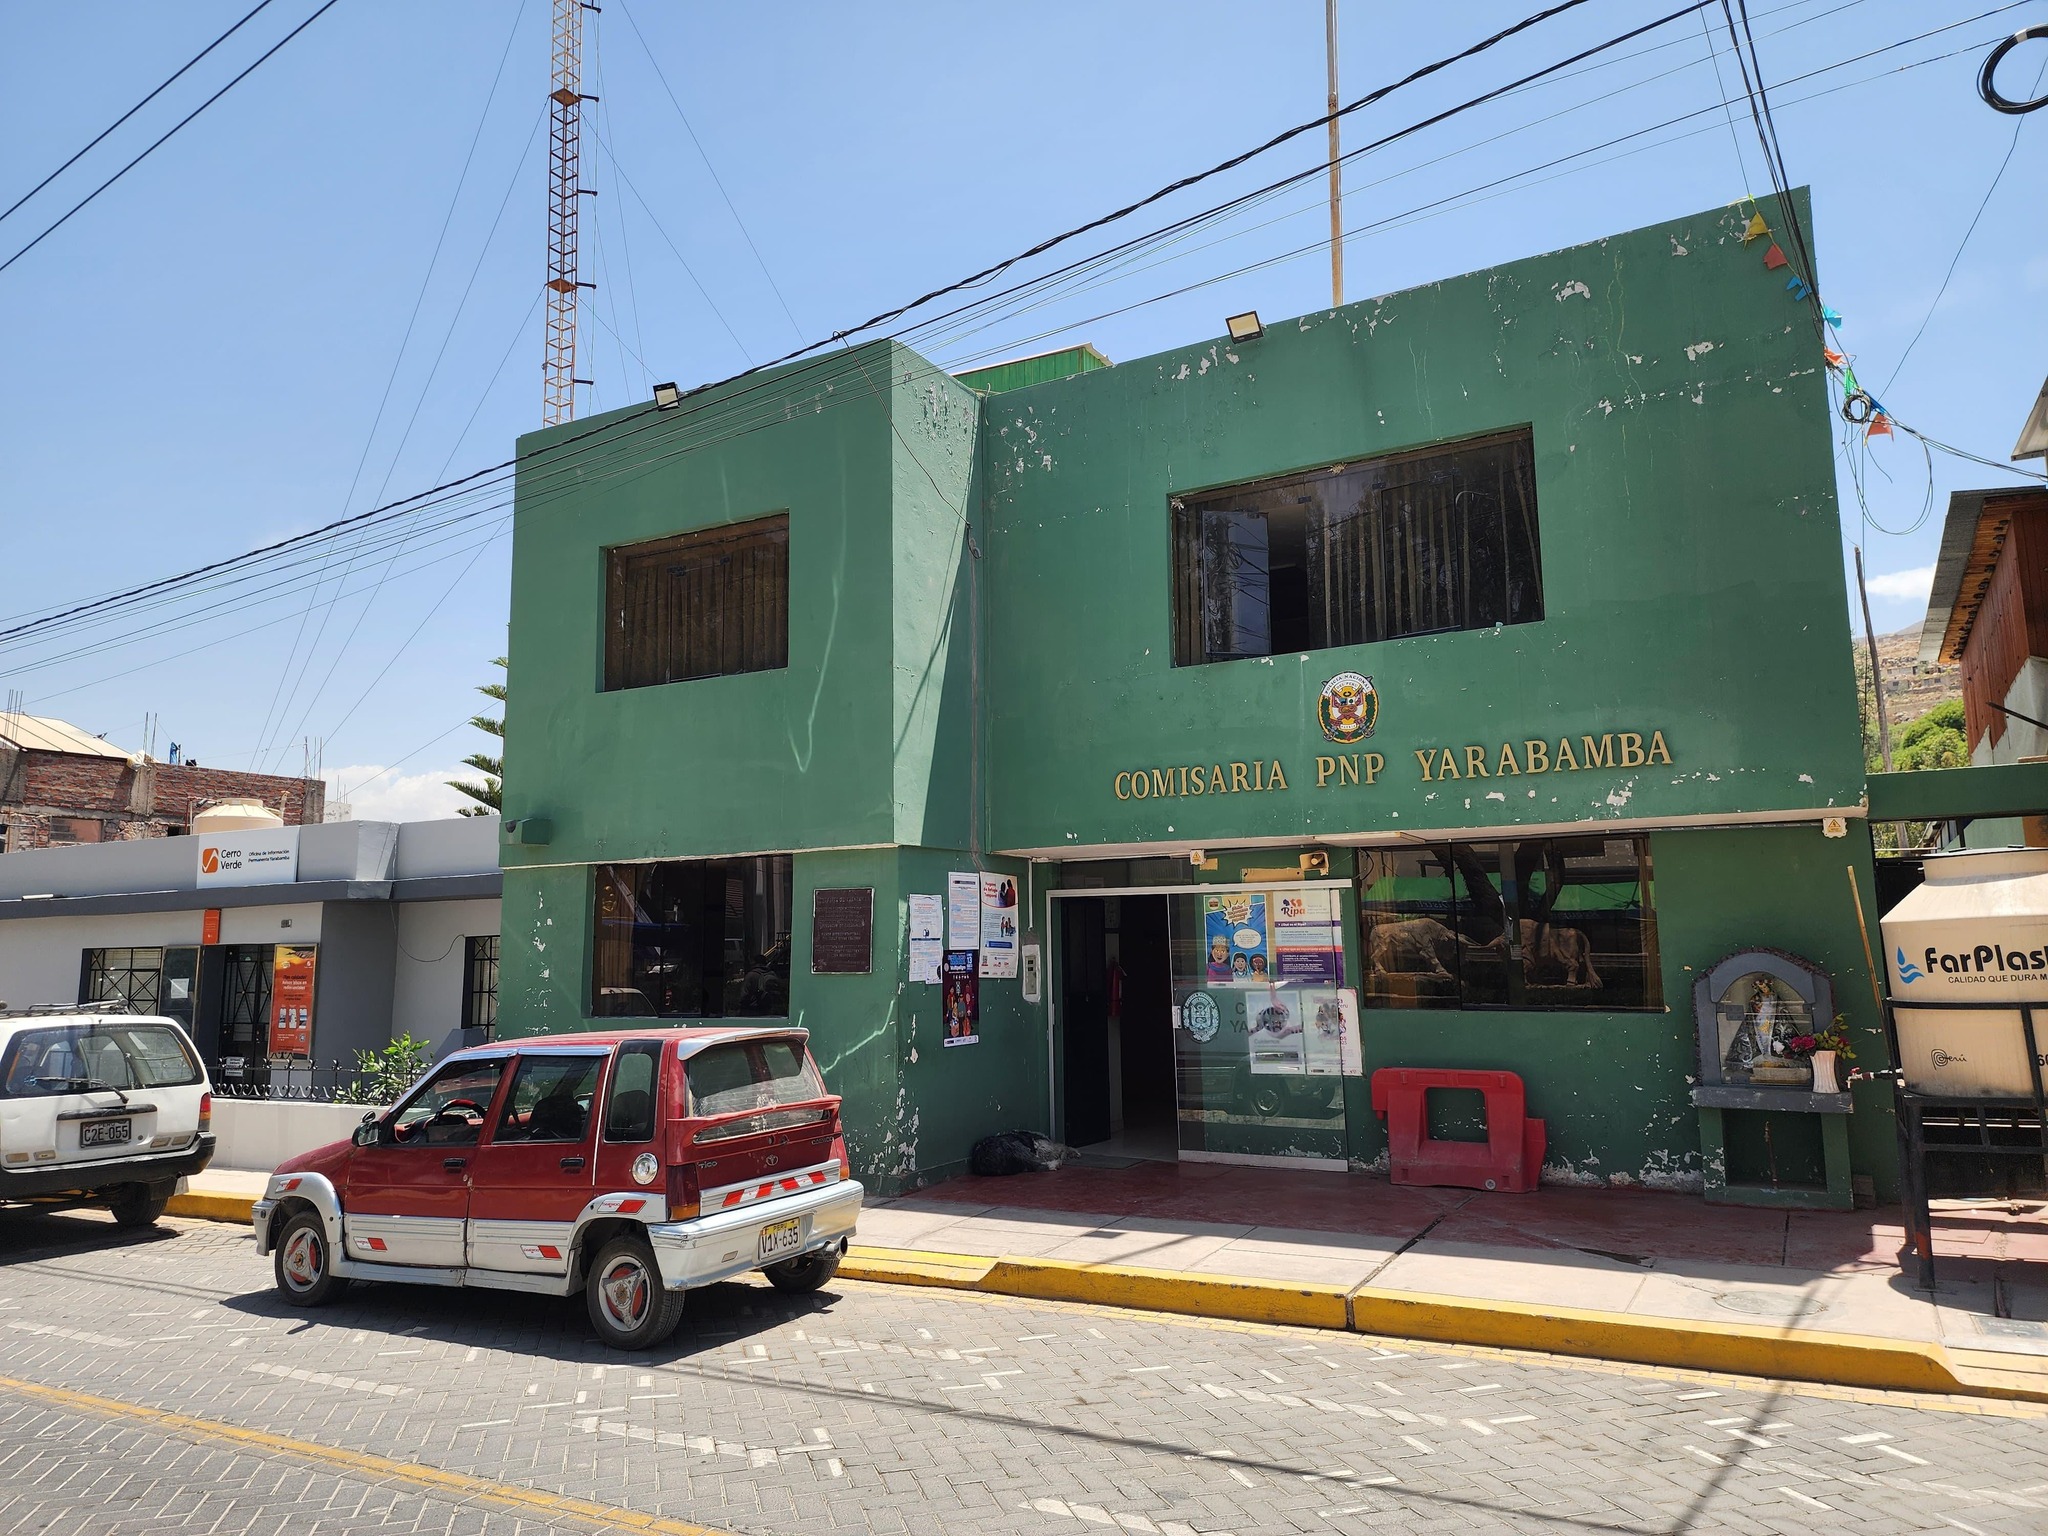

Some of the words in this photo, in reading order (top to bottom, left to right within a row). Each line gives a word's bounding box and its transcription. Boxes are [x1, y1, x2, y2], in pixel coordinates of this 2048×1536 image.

[1114, 760, 1288, 800] COMISARIA
[1316, 753, 1385, 787] PNP
[1414, 730, 1673, 782] YARABAMBA
[221, 849, 242, 858] Cerro
[221, 860, 242, 869] Verde
[1281, 907, 1305, 917] Ripa
[1948, 976, 1986, 984] CALIDAD
[1988, 975, 2009, 983] QUE
[2010, 974, 2038, 982] DURA
[84, 1125, 128, 1142] C2E-055
[761, 1225, 799, 1254] V1X-635
